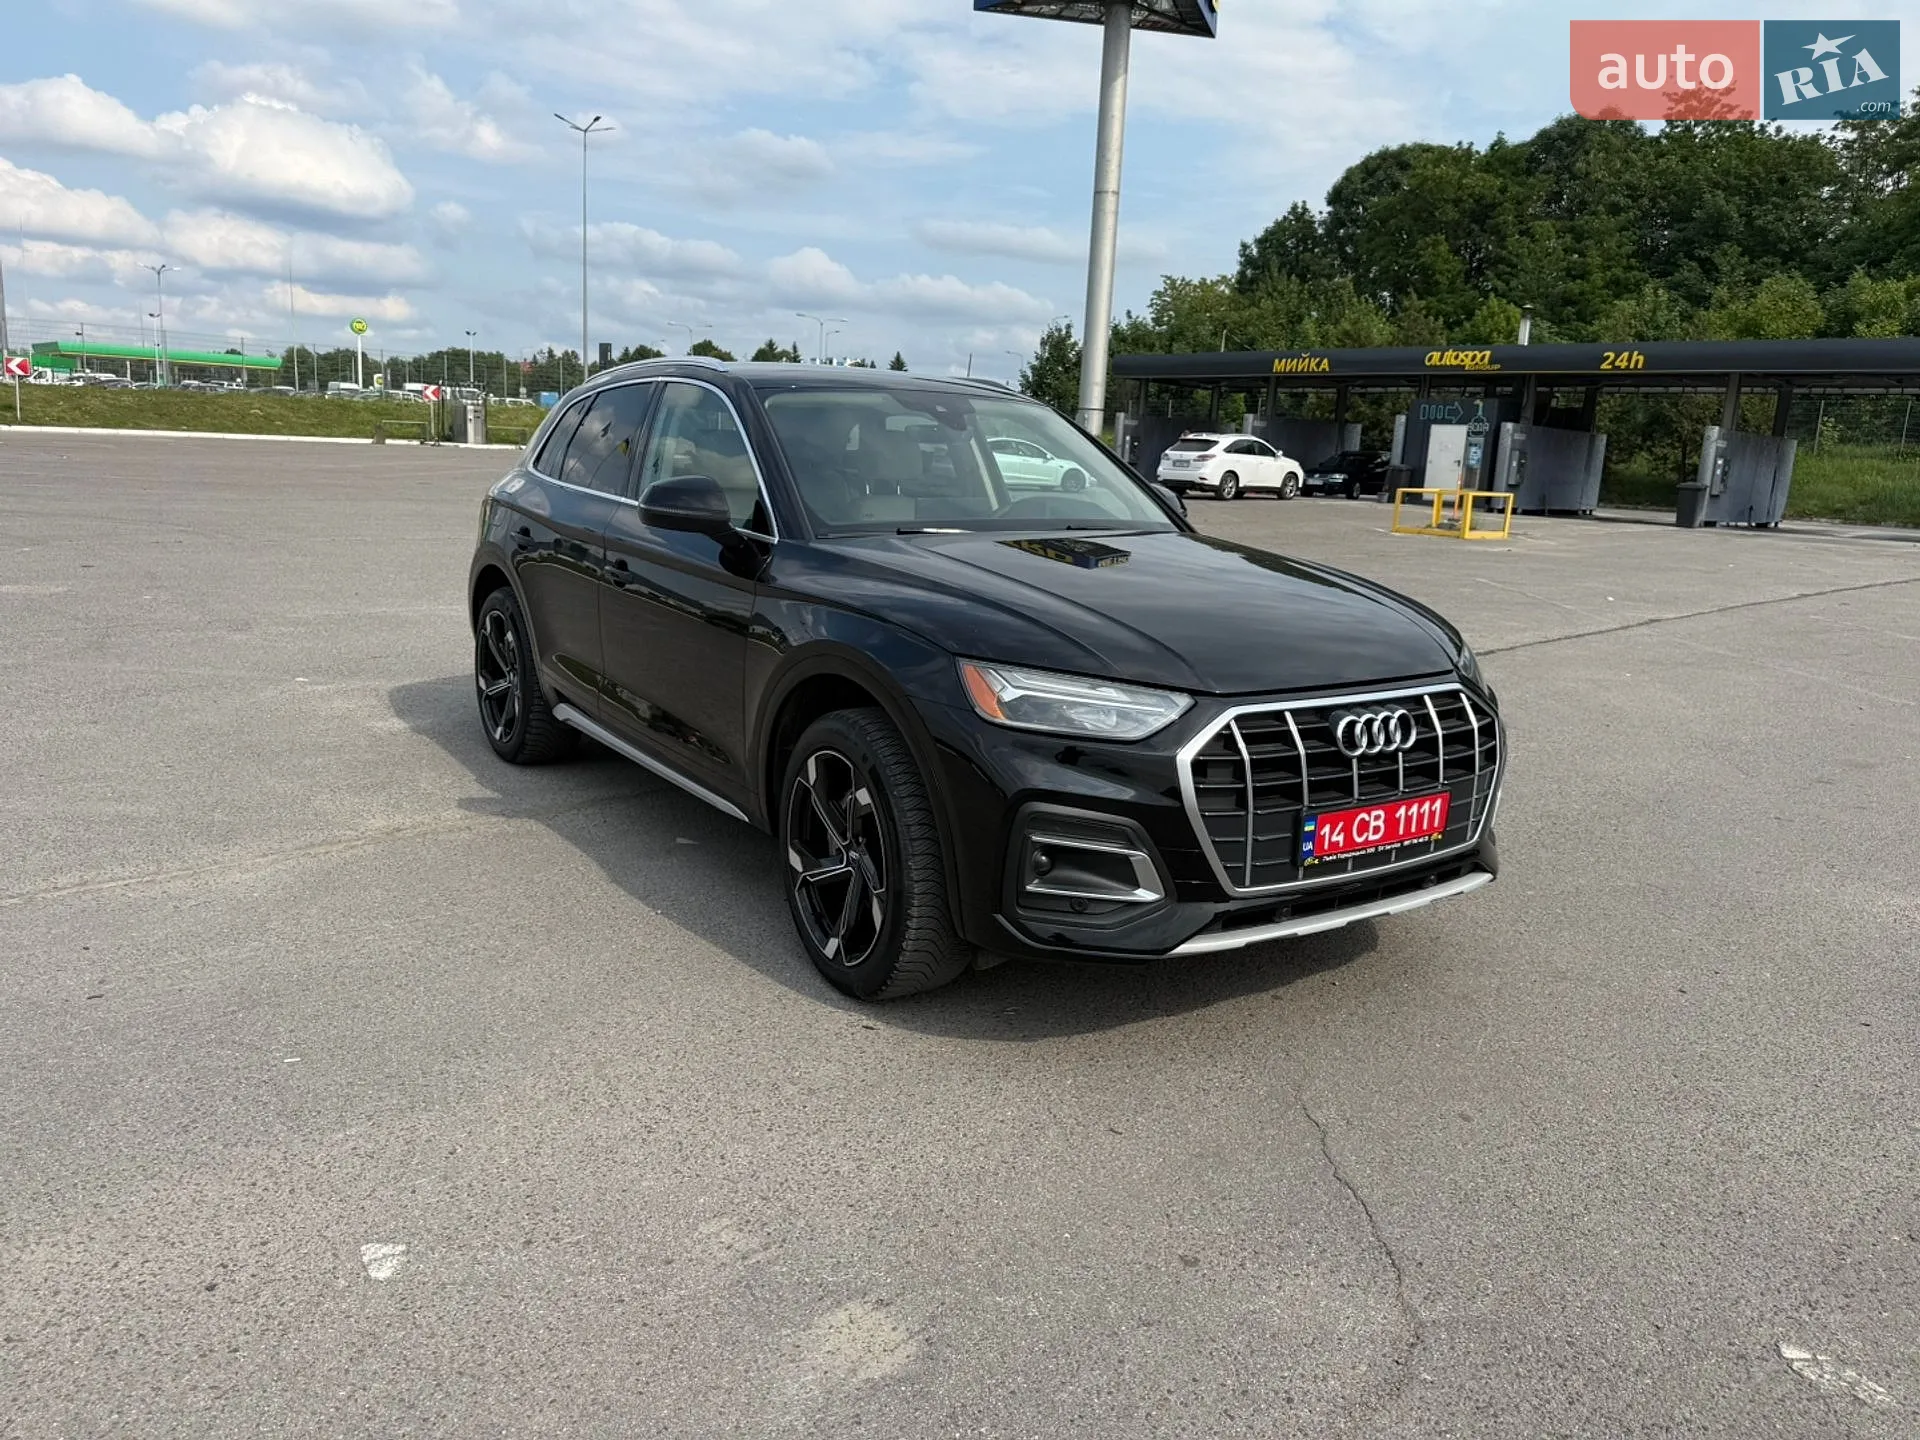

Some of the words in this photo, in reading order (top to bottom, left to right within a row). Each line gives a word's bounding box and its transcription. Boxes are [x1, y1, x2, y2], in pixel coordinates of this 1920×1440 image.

[1272, 352, 1330, 373] МИЙКА
[1424, 348, 1492, 370] autospa
[1600, 350, 1645, 369] 24h
[1320, 821, 1345, 850] 14
[1352, 809, 1385, 843] CB
[1395, 798, 1442, 836] 1111
[1303, 842, 1313, 851] UA
